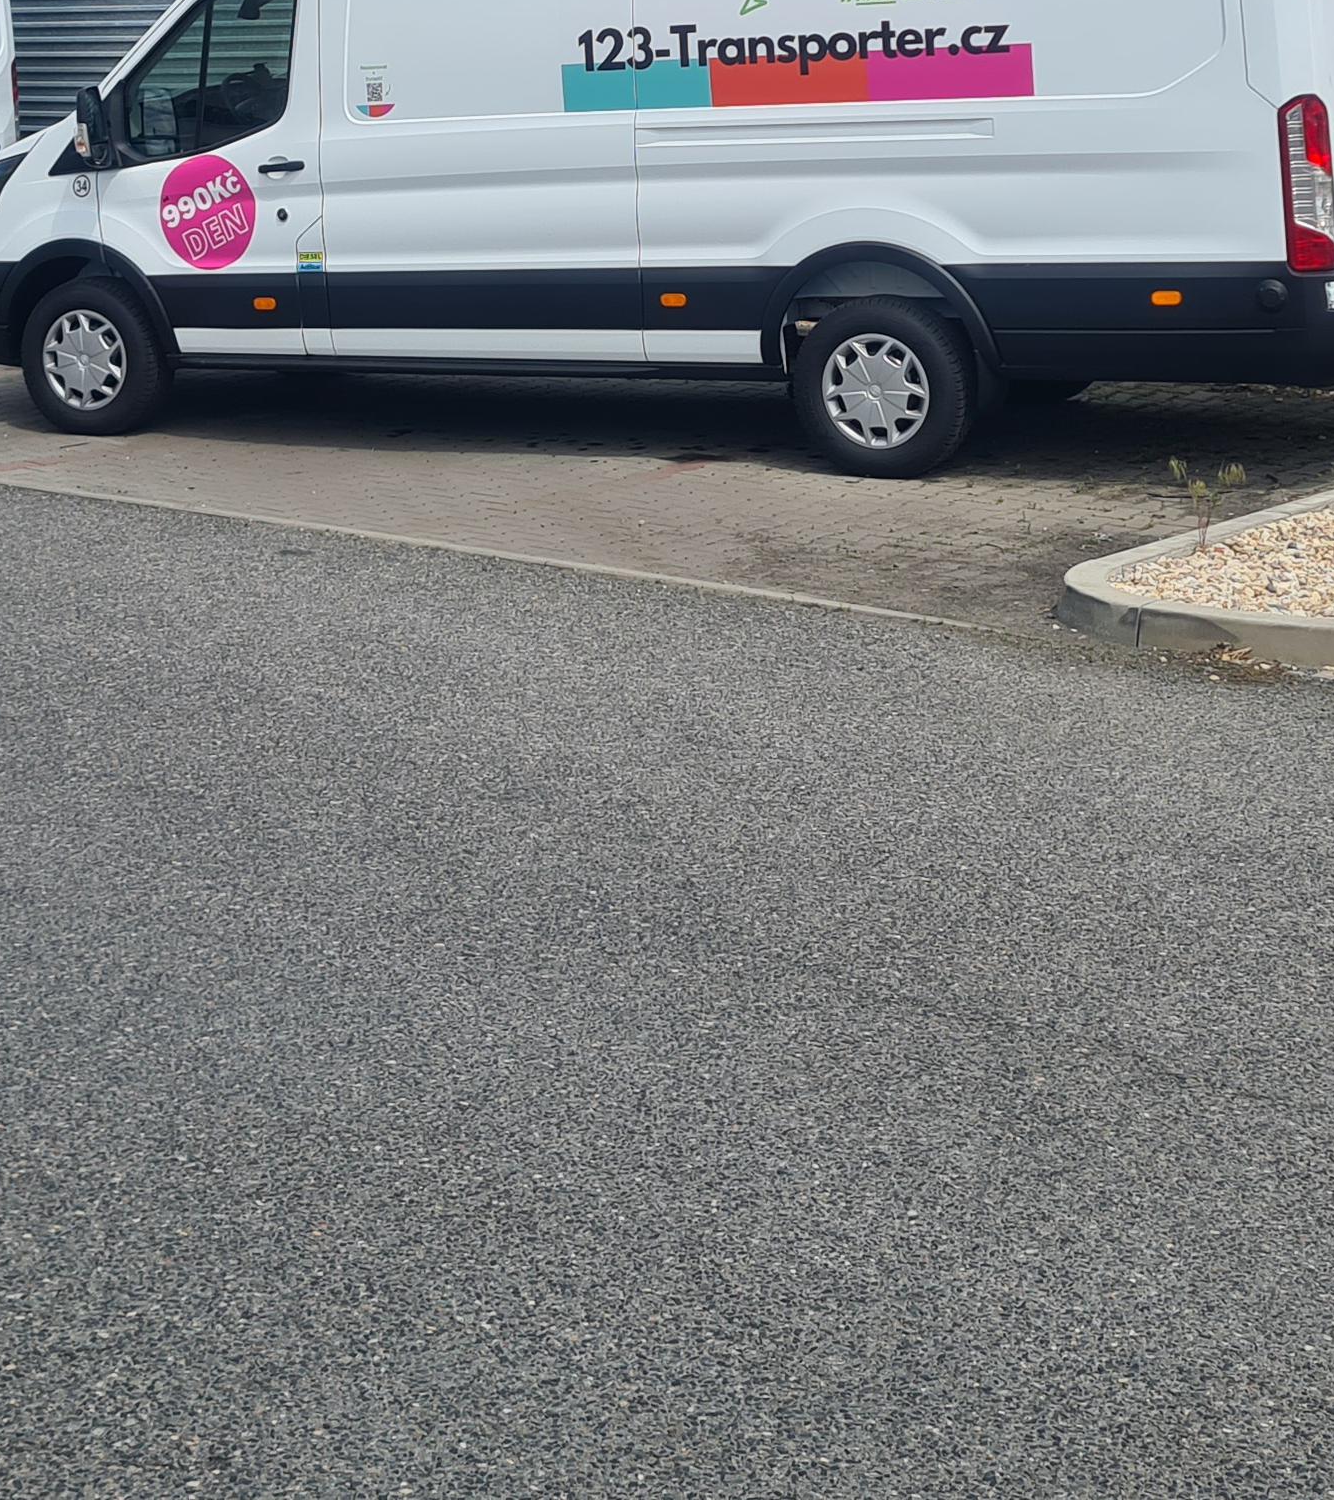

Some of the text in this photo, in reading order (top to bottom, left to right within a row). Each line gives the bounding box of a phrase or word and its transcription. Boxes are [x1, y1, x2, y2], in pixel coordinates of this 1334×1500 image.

[577, 20, 1011, 75] 123-Transporter.cz
[76, 180, 88, 193] 34
[162, 169, 242, 228] 990Kč
[182, 203, 249, 260] DEN
